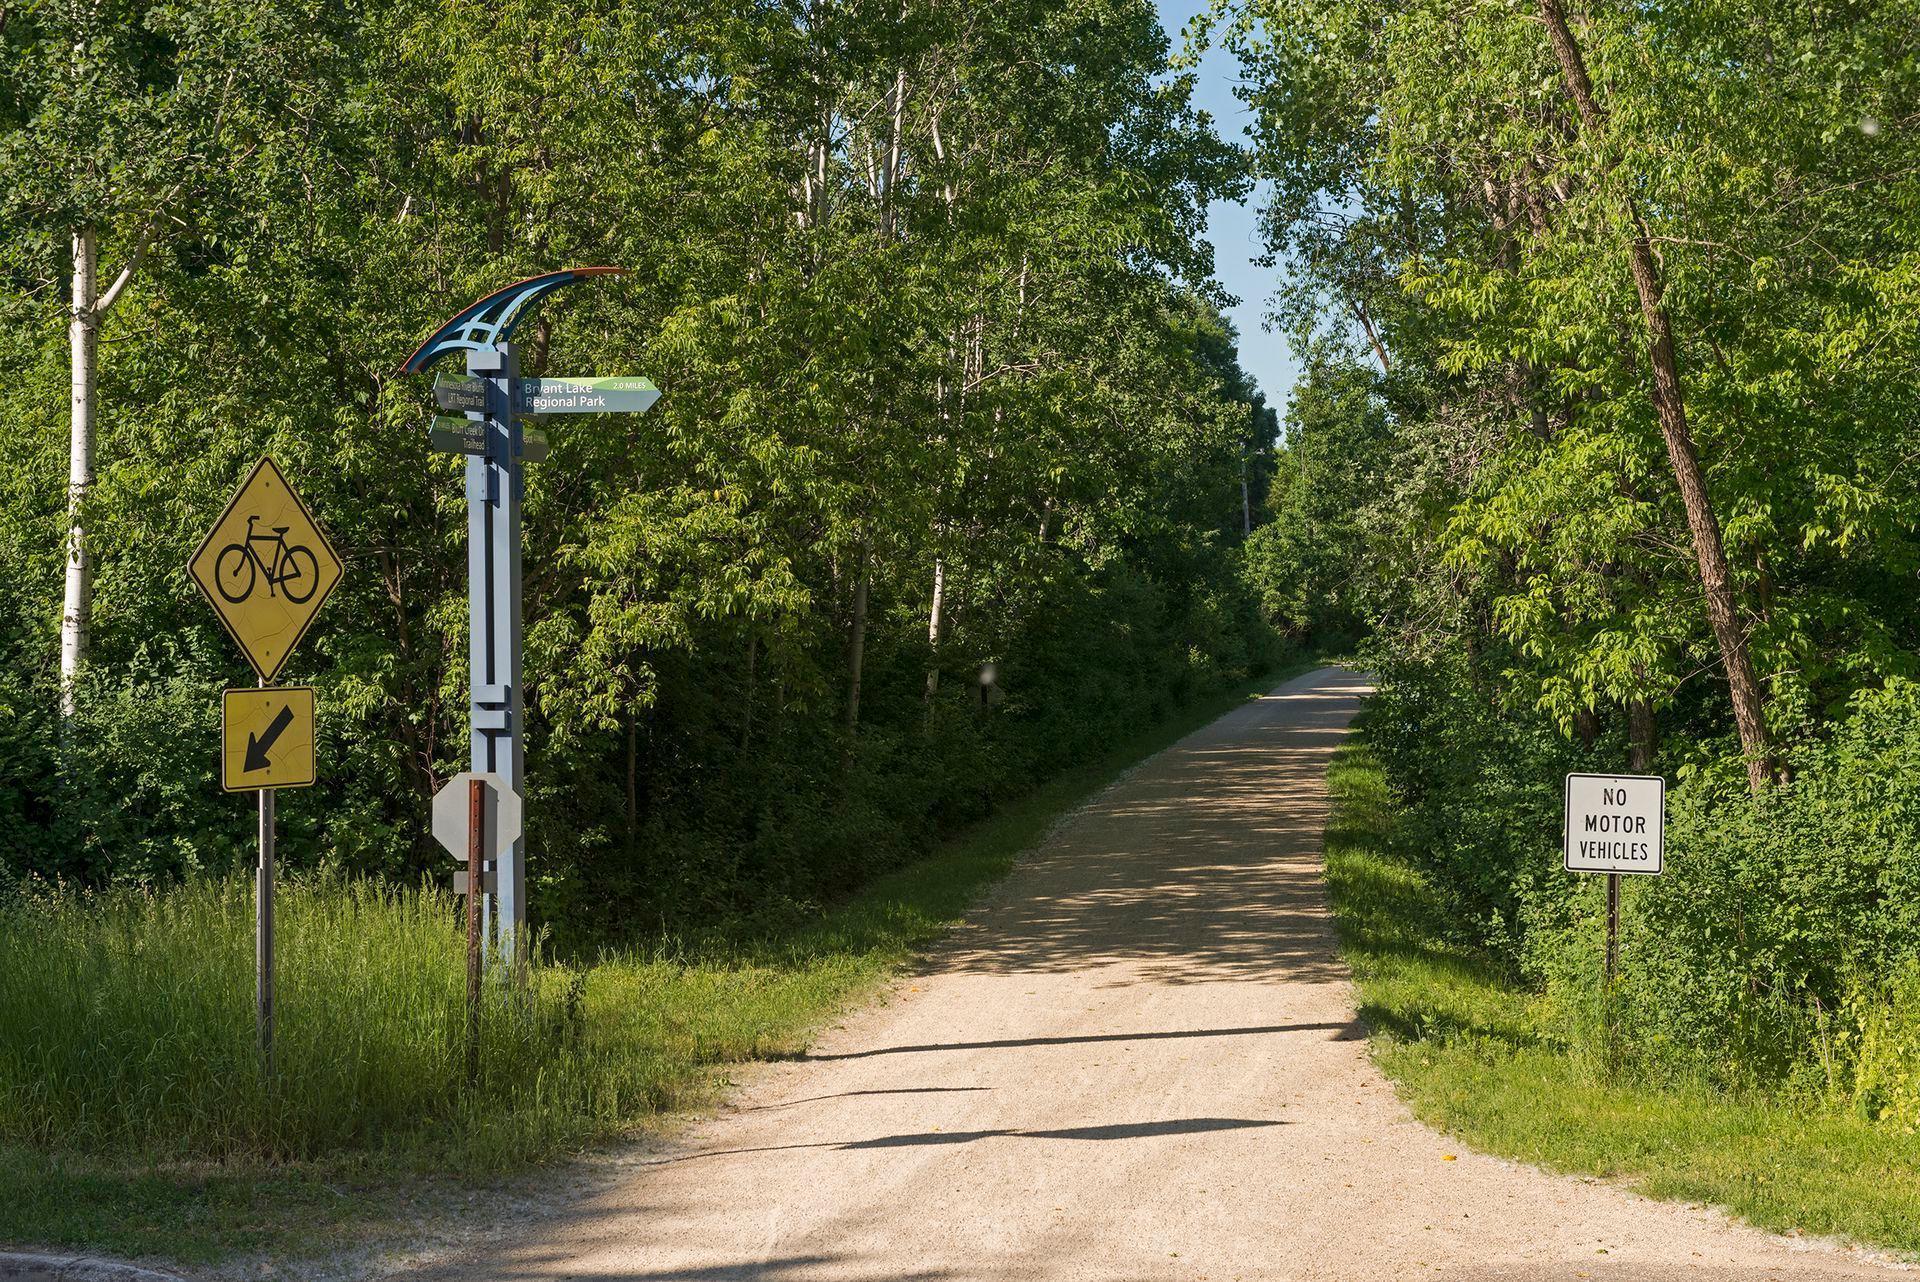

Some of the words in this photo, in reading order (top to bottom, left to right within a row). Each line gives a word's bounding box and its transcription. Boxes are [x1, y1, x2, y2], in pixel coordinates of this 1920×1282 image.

[525, 383, 566, 397] Bryant
[566, 383, 593, 394] Lake
[613, 382, 624, 390] 2.0
[625, 382, 646, 390] MILES
[475, 395, 485, 407] Trail
[525, 396, 577, 409] Regional
[580, 396, 606, 407] Park
[464, 424, 477, 436] Creek
[463, 437, 485, 450] Trailhead
[1603, 788, 1627, 806] NO
[1585, 814, 1646, 834] MOTOR
[1580, 841, 1648, 861] VEHICLES
